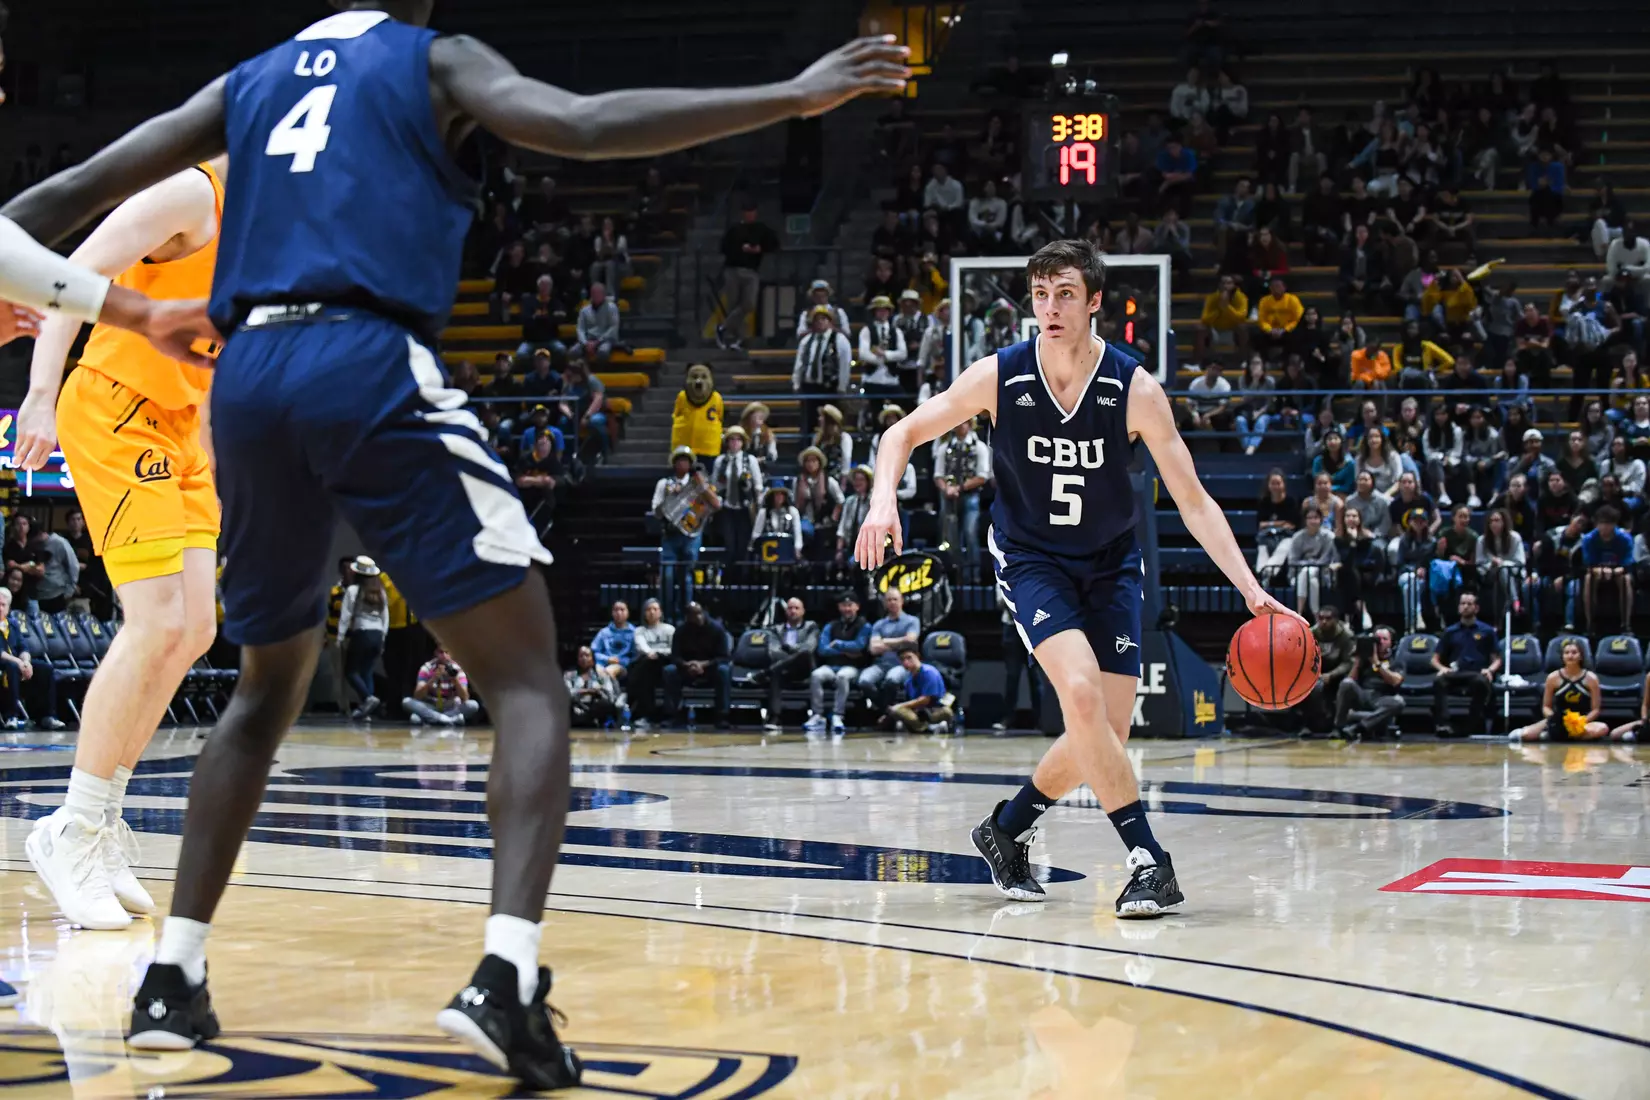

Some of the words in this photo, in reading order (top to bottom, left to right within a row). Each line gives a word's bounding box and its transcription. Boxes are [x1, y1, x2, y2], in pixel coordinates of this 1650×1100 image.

[293, 49, 337, 77] LO
[264, 83, 338, 173] 4
[1052, 114, 1103, 142] 3:38
[1060, 142, 1096, 185] 19
[1096, 395, 1117, 407] WAC
[134, 448, 172, 483] Cal
[1027, 435, 1105, 469] CBU
[1049, 473, 1085, 526] 5
[761, 539, 779, 562] C
